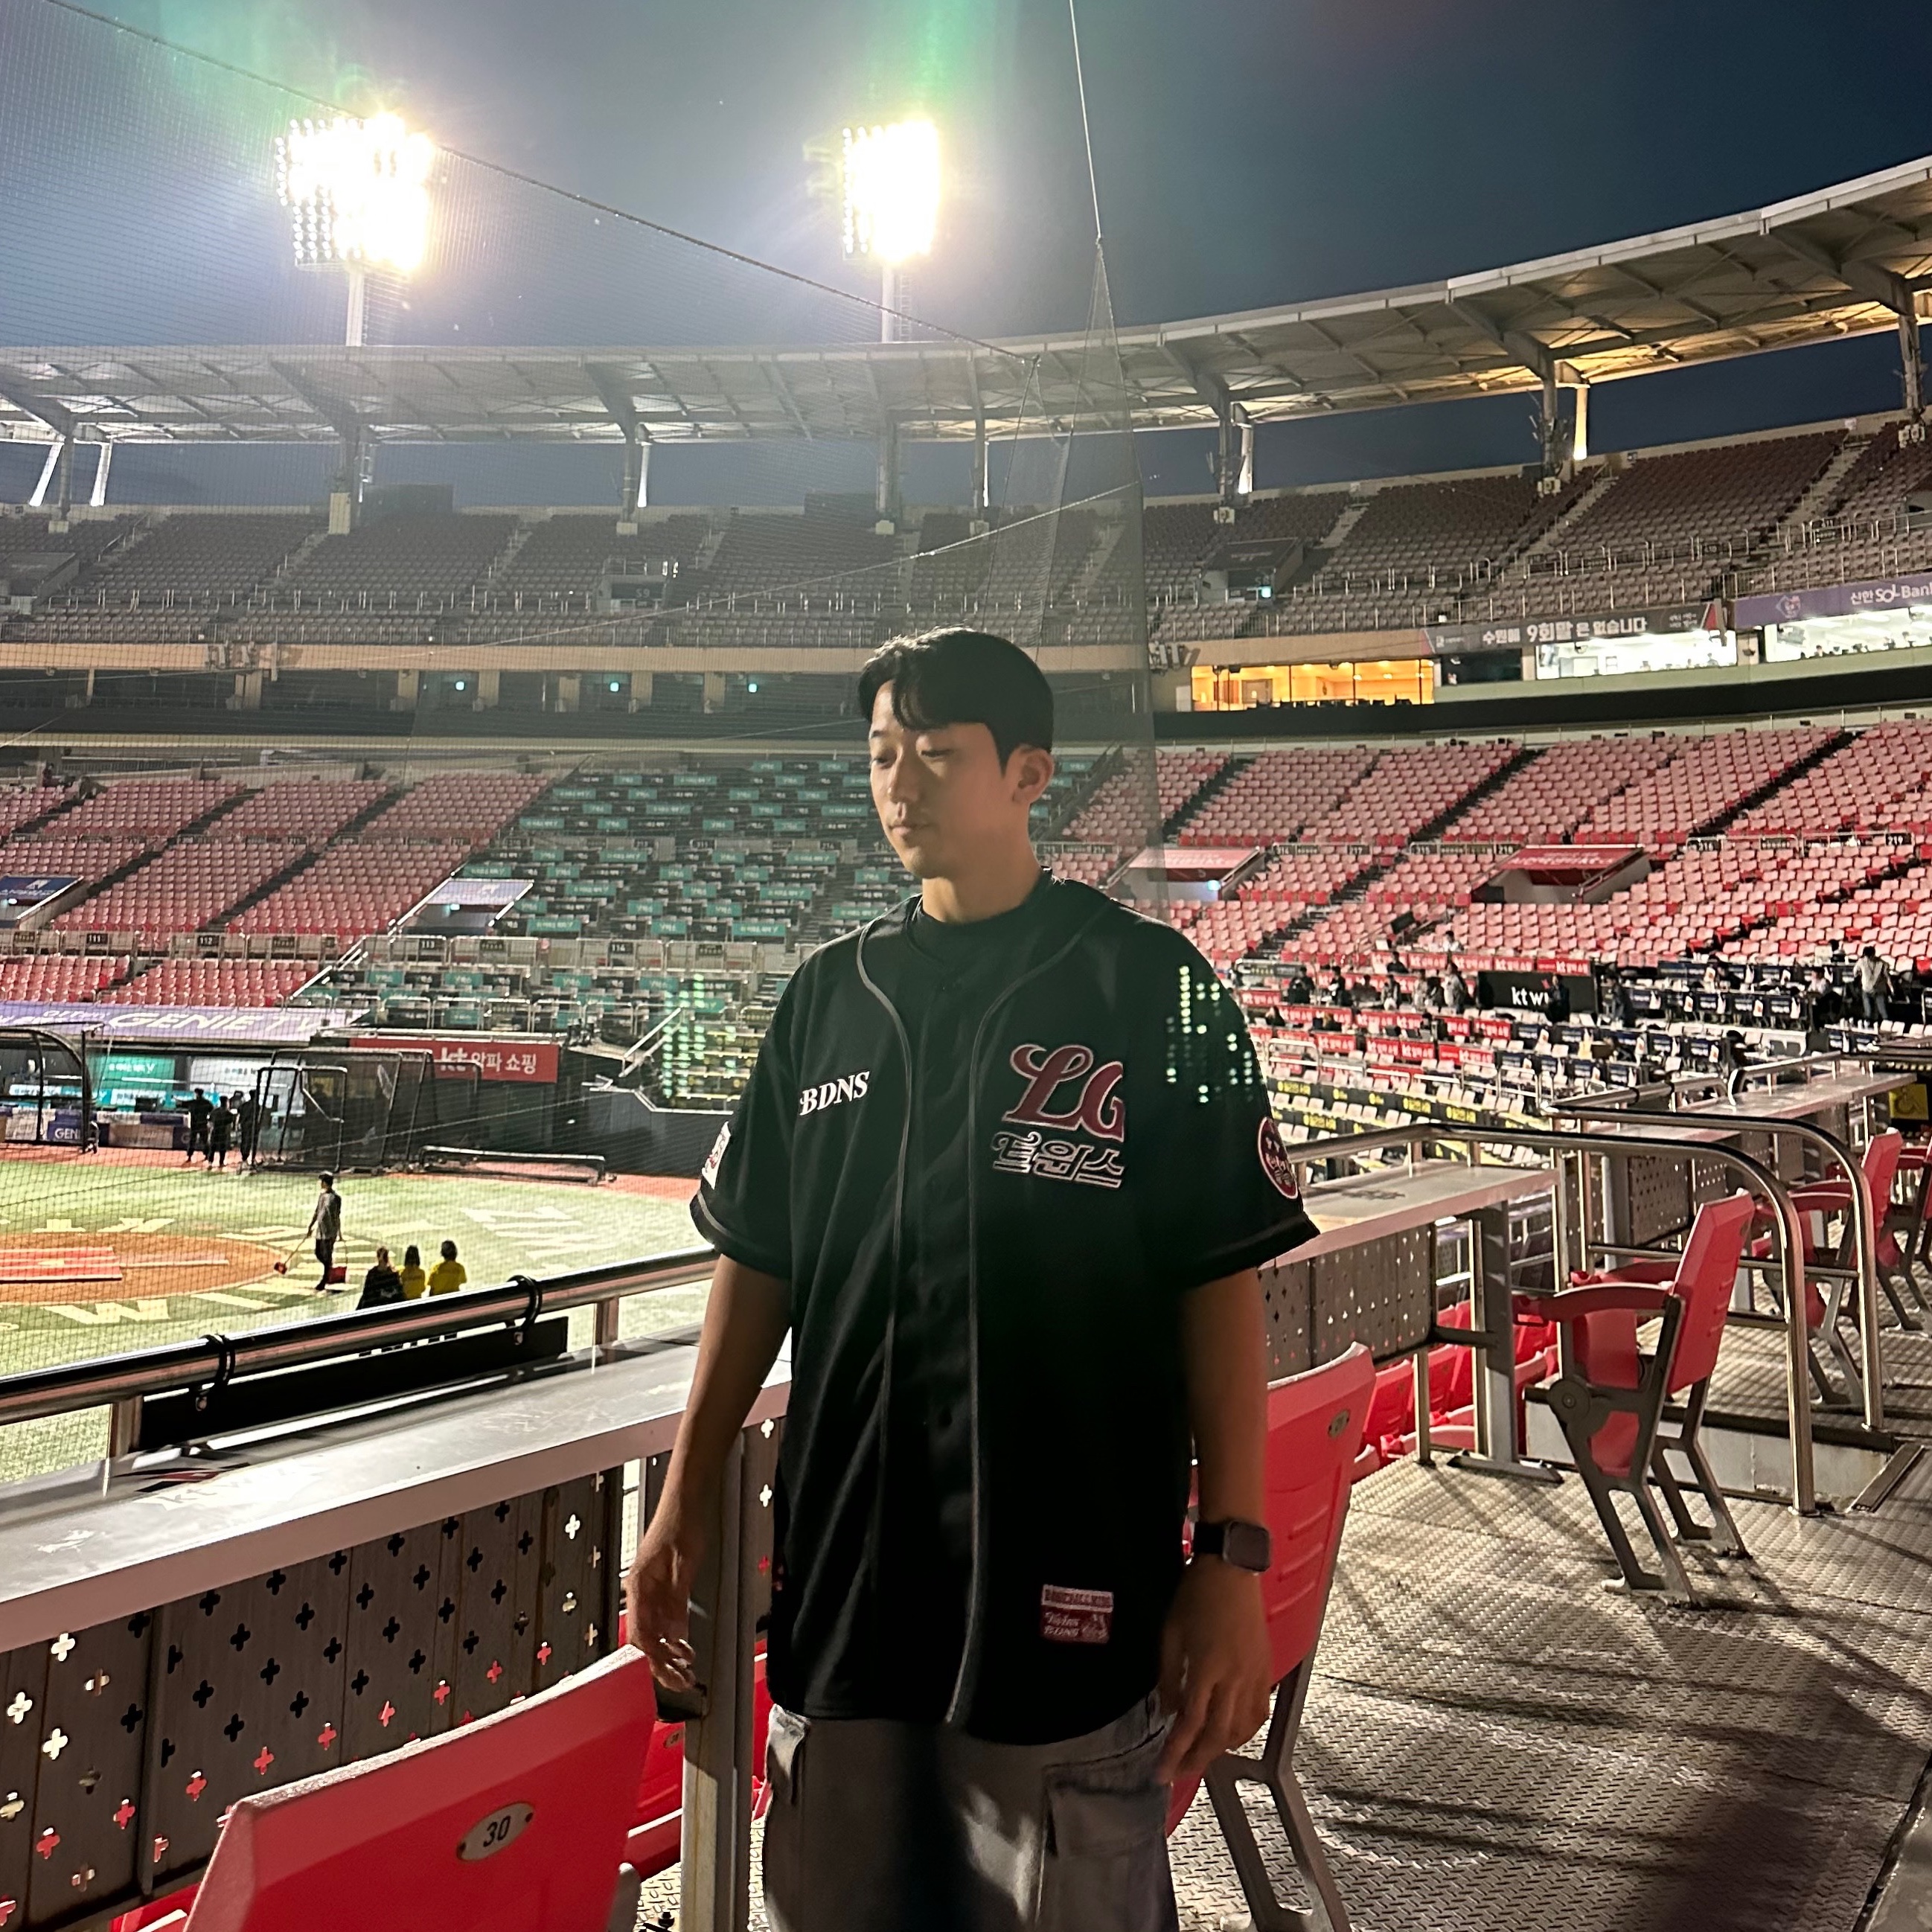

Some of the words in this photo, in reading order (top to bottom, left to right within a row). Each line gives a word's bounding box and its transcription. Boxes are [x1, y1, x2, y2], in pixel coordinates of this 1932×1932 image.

[1482, 628, 1520, 645] 수원에
[1593, 617, 1647, 636] 없습니다
[88, 934, 103, 944] 111
[199, 935, 214, 944] 112
[1511, 986, 1528, 1006] kt
[1529, 991, 1550, 1006] wi
[109, 1011, 260, 1031] GENIE
[505, 1053, 537, 1075] 쇼핑
[799, 1070, 870, 1117] BDNS
[1002, 1043, 1125, 1142] LG
[482, 1814, 512, 1848] 30
